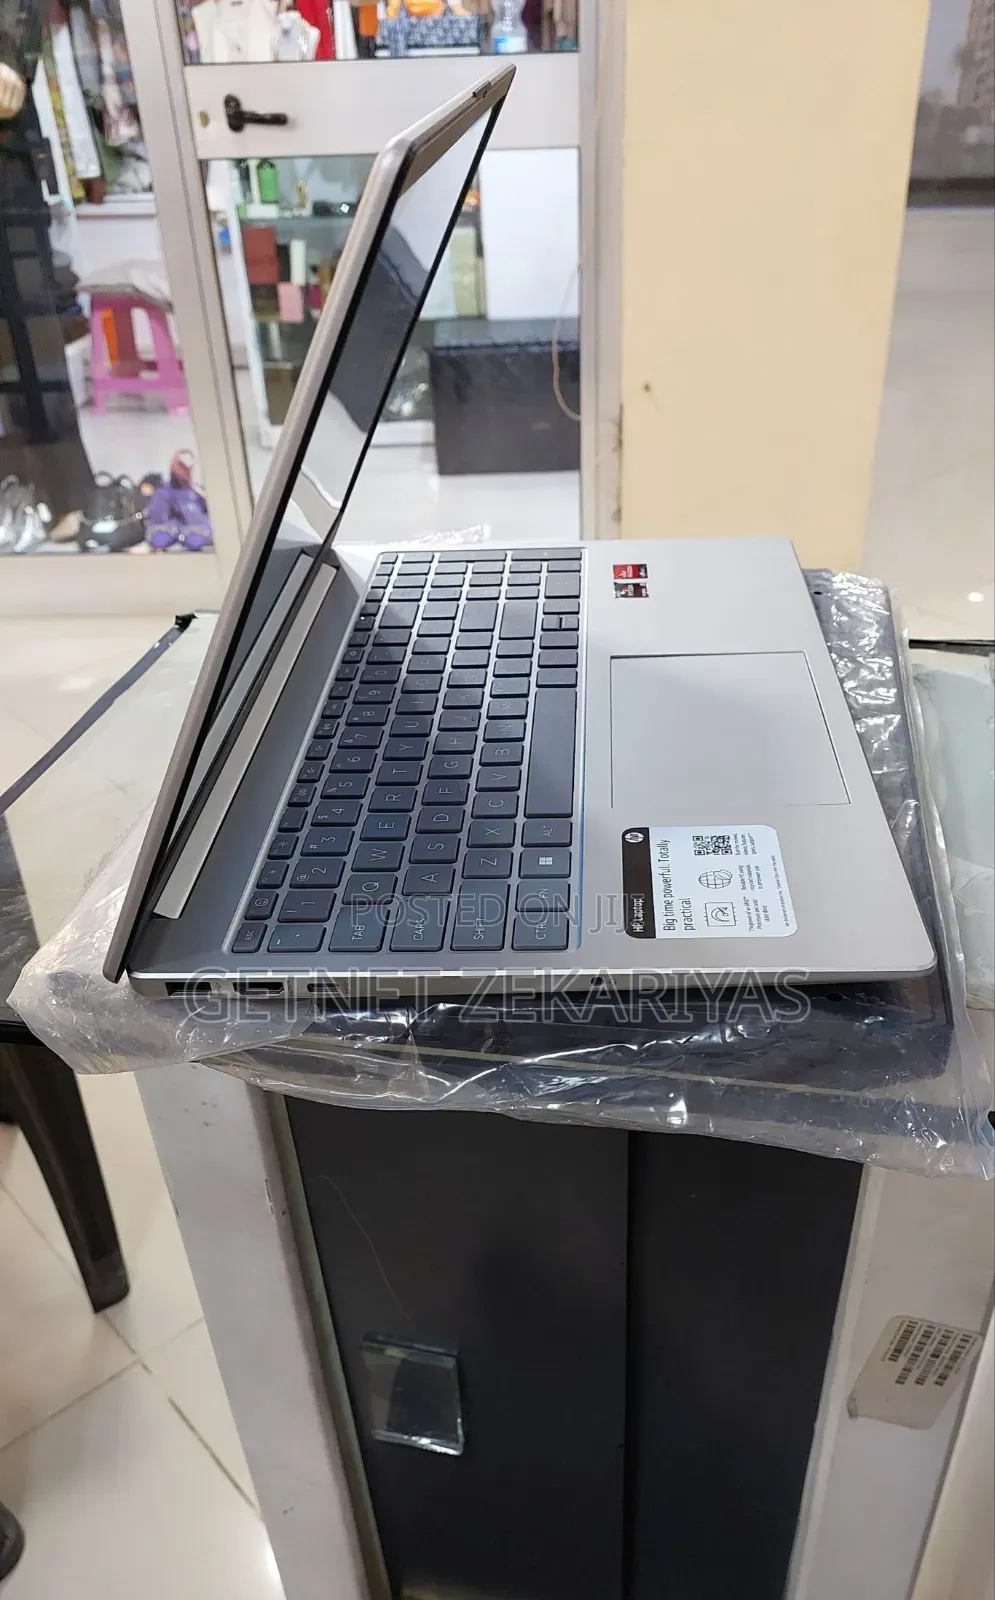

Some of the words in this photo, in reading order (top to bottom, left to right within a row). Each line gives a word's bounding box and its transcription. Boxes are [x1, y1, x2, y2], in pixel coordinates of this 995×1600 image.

[494, 748, 510, 756] B
[444, 760, 458, 769] G
[491, 773, 506, 781] V
[488, 800, 504, 808] C
[433, 813, 449, 822] D
[484, 827, 500, 836] X
[542, 824, 553, 837] ALT
[428, 843, 444, 851] S
[656, 839, 671, 862] Totally
[368, 848, 388, 862] W
[480, 858, 497, 866] Z
[296, 874, 310, 882] @
[422, 872, 438, 883] A
[658, 864, 676, 898] powerful.
[362, 881, 380, 892] Q
[538, 888, 549, 899] FN
[632, 898, 645, 922] Laptop
[662, 900, 674, 917] time
[412, 918, 427, 941] CAPS
[473, 917, 486, 940] SHIFT
[662, 917, 678, 931] Big
[352, 924, 366, 941] TAB
[535, 920, 548, 940] CTRL
